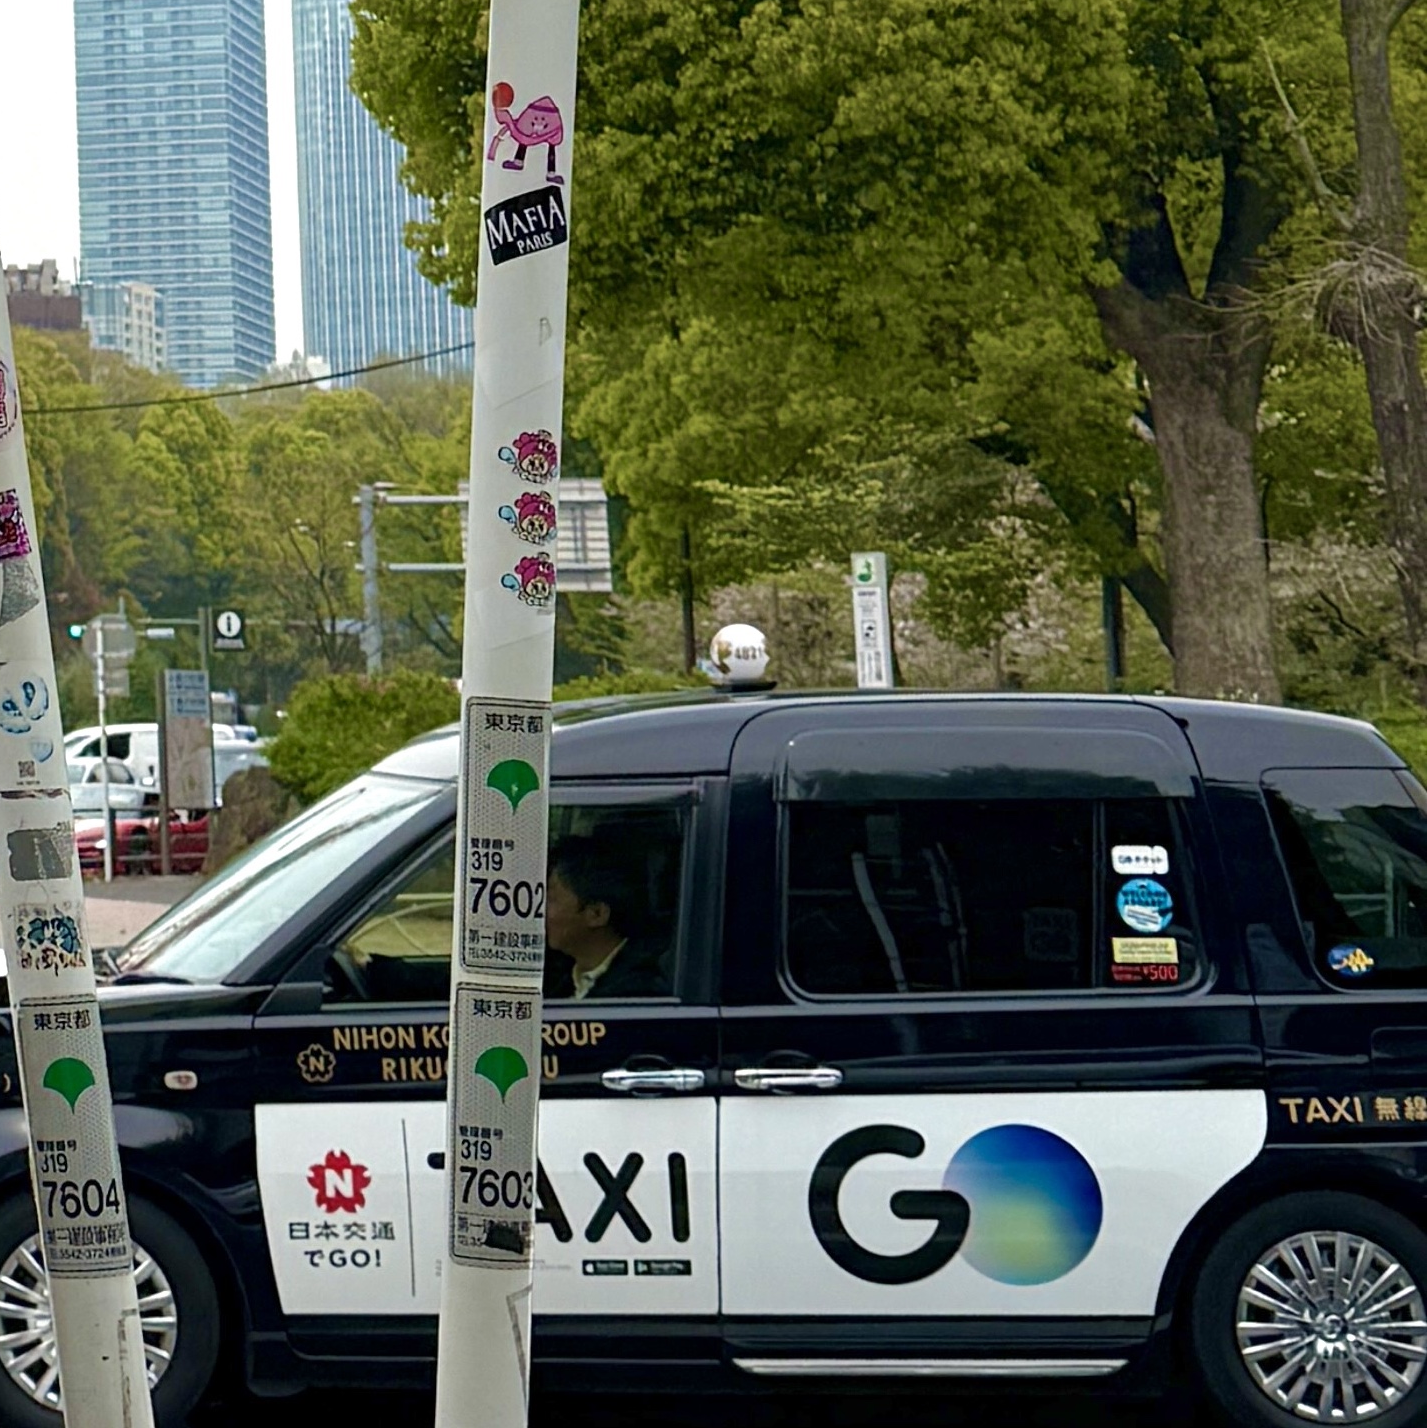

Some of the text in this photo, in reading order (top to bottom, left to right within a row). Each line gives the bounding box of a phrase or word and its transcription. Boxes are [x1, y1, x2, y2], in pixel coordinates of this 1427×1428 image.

[486, 194, 566, 250] MAFIA
[516, 230, 554, 254] PARIS
[484, 712, 544, 734] 東京都
[471, 851, 504, 872] 319
[469, 877, 545, 919] 7602
[33, 1009, 92, 1031] 東京都
[473, 998, 533, 1020] 東京都
[333, 1026, 417, 1051] NIHON
[542, 1022, 607, 1047] ROUP
[1277, 1096, 1365, 1124] TAXI
[461, 1140, 493, 1161] 319
[324, 1169, 355, 1198] N
[460, 1166, 534, 1210] 7603
[42, 1179, 121, 1219] 7604
[808, 1123, 1104, 1286] GO
[288, 1222, 396, 1241] 日本交通
[304, 1249, 382, 1268] でGO!
